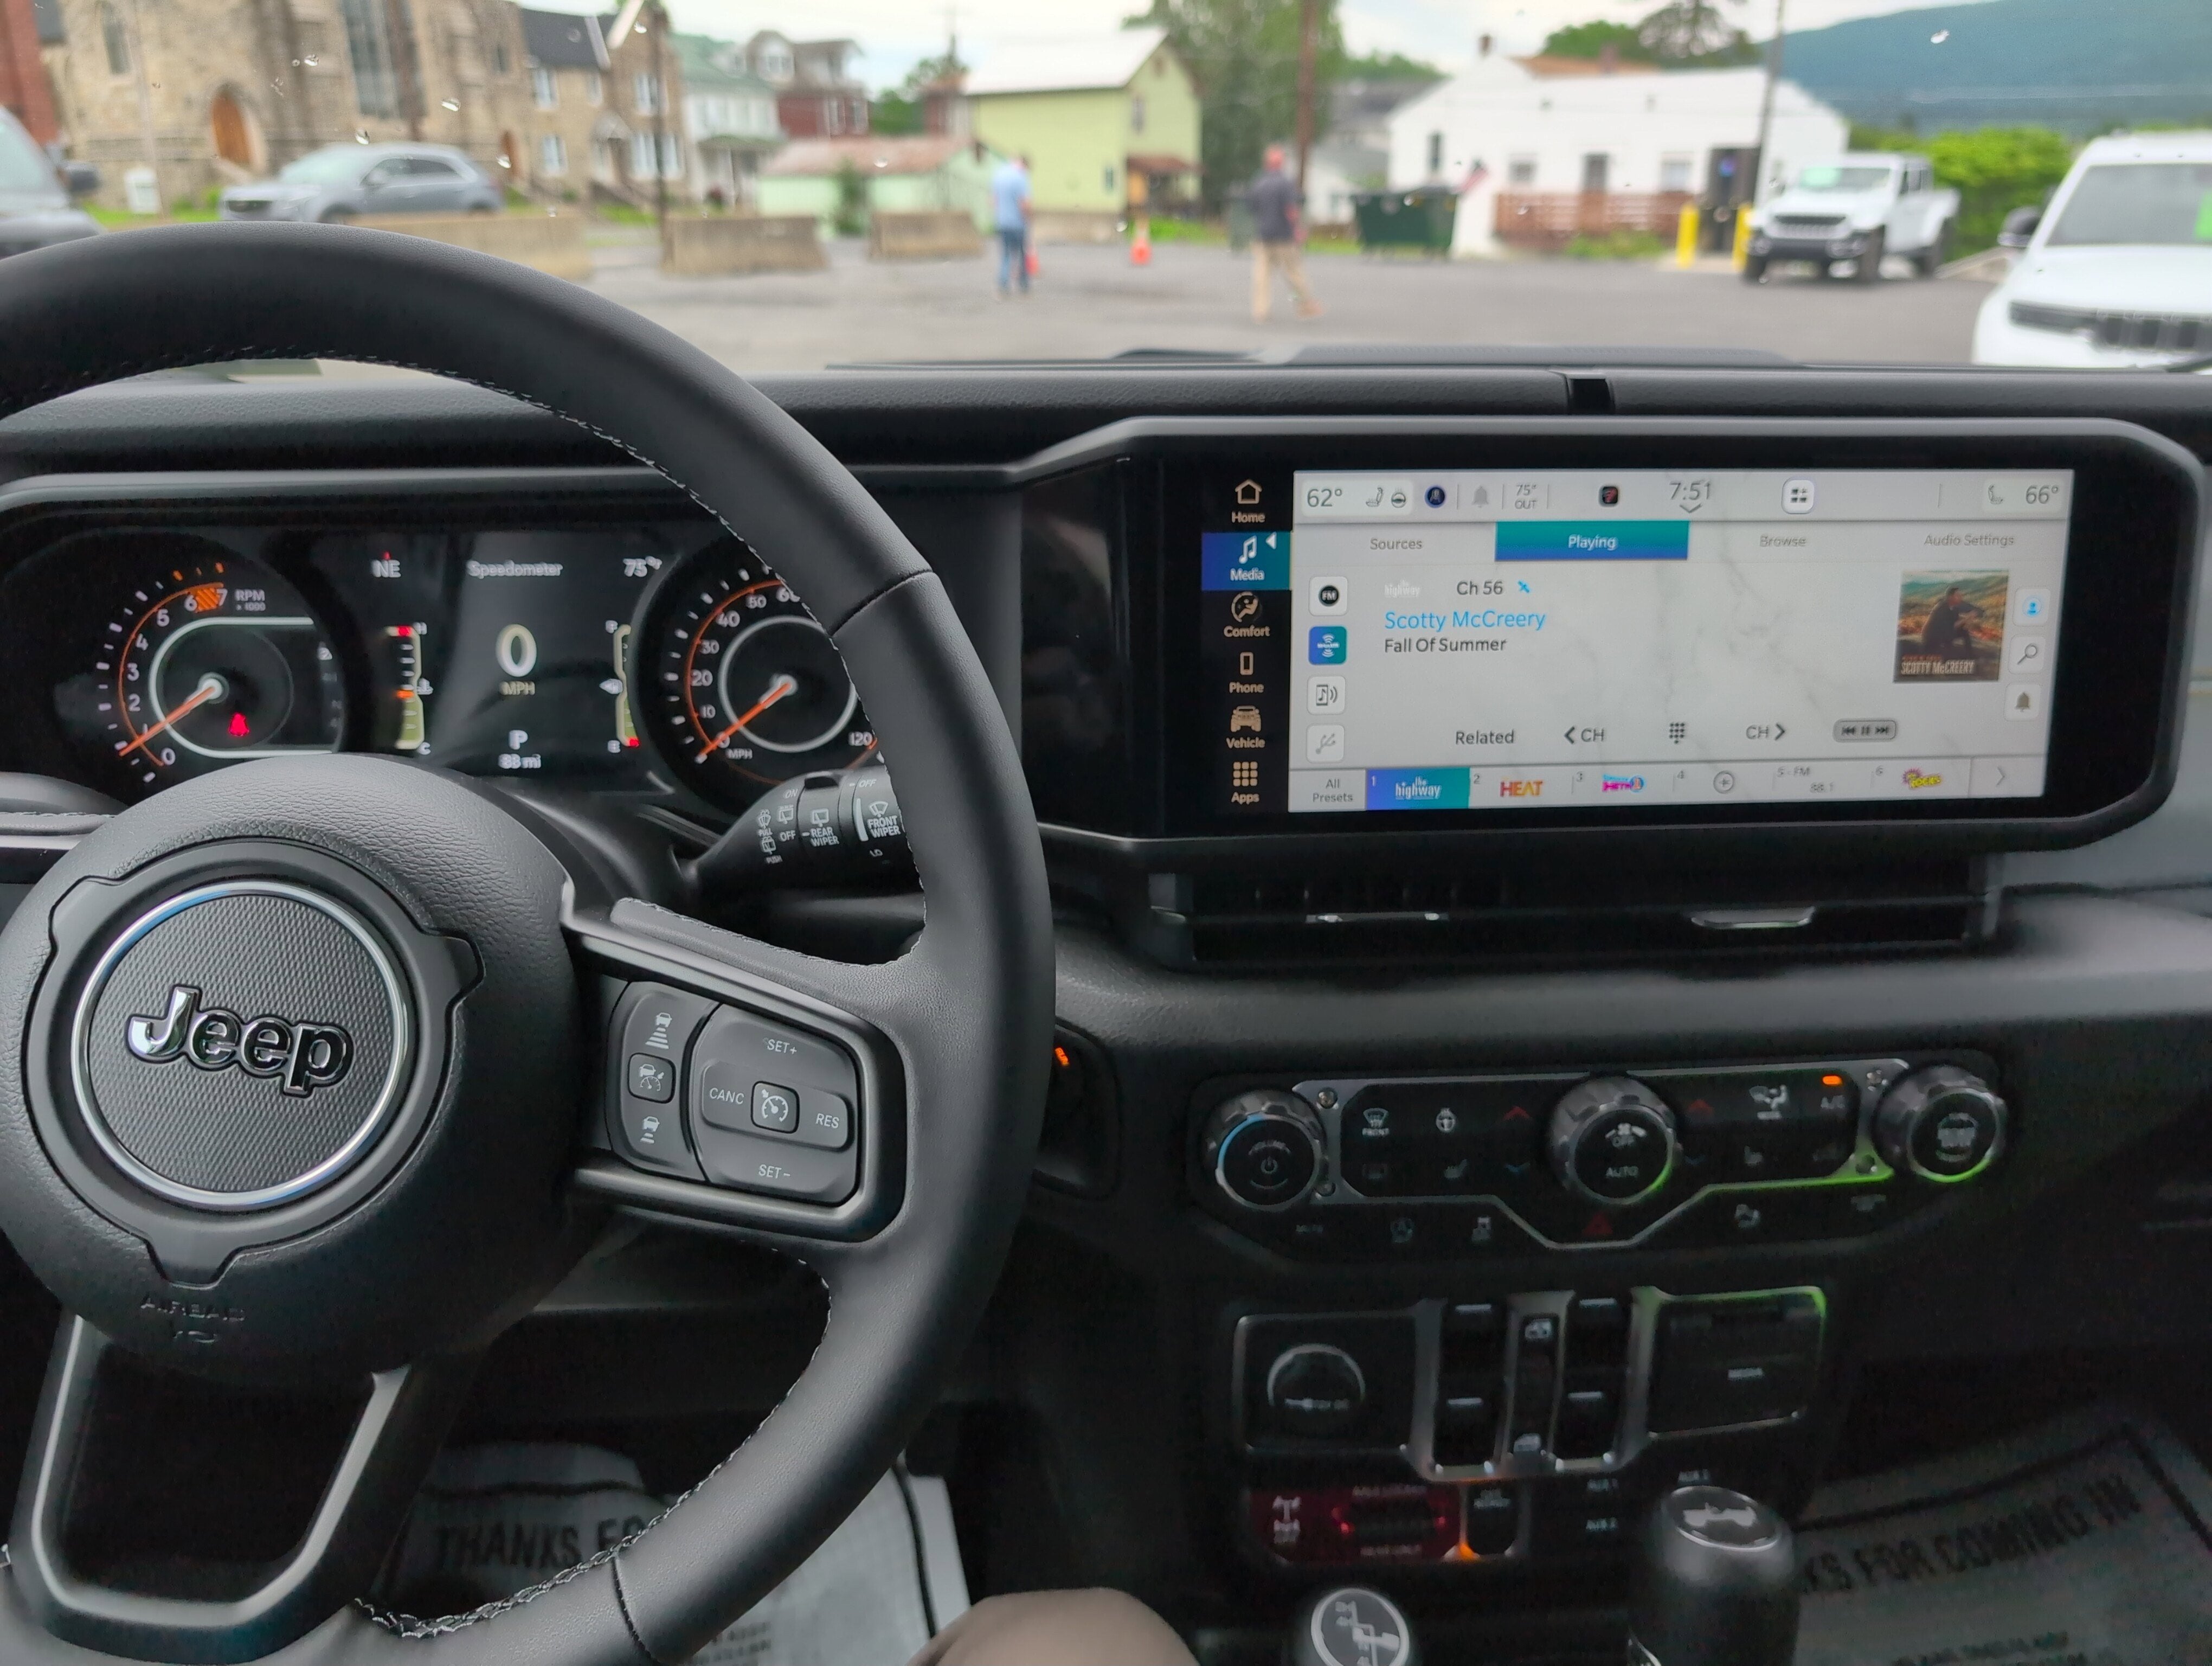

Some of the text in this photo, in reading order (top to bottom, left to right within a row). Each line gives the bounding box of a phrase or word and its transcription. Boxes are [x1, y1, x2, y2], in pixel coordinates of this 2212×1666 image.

[1307, 488, 1342, 508] 62°
[1669, 480, 1711, 501] 7:51
[2025, 485, 2059, 504] 66°
[1514, 499, 1537, 510] OUT
[1231, 510, 1266, 523] Home
[1369, 538, 1423, 550] Sources
[1568, 534, 1617, 551] Playing
[1759, 535, 1806, 547] Browse
[1925, 533, 2015, 548] Audio Settings
[371, 559, 401, 578] NE
[466, 559, 563, 579] Speedometer
[1230, 567, 1265, 581] Media
[234, 588, 266, 601] RPM
[1456, 580, 1503, 596] Ch 56
[184, 595, 197, 612] 6
[745, 594, 767, 609] 50
[1321, 591, 1336, 601] FM
[157, 609, 170, 627] 5
[716, 610, 741, 627] 40
[1384, 611, 1547, 632] Scotty McCreery
[1223, 624, 1271, 638] Comfort
[136, 633, 149, 651] 4
[700, 639, 720, 655] 30
[1385, 637, 1508, 653] Fall Of Summer
[496, 624, 537, 677] 0
[127, 662, 140, 682] 3
[1901, 661, 1932, 675] SCOTTY
[691, 669, 713, 687] 20
[499, 681, 536, 696] MPH
[1229, 681, 1265, 694] Phone
[128, 693, 142, 712] 2
[699, 704, 716, 719] 10
[509, 729, 529, 751] P
[848, 732, 873, 747] 120
[1455, 728, 1605, 745] Related CH
[1746, 725, 1770, 740] CH
[1226, 735, 1266, 749] Vehicle
[160, 747, 176, 766] 0
[725, 748, 753, 760] MPH
[859, 779, 877, 787] OFF
[1325, 778, 1340, 789] All
[1371, 775, 1377, 787] 1
[1473, 773, 1481, 785] 2
[1576, 771, 1584, 783] 3
[785, 788, 798, 799] ON
[1394, 782, 1442, 800] highway
[1500, 780, 1544, 797] HEAT
[1231, 791, 1260, 805] Apps
[1312, 792, 1354, 803] Presets
[867, 815, 898, 829] FRONT
[757, 827, 773, 837] PULL
[779, 829, 796, 842] OFF
[809, 826, 834, 838] REAR
[870, 825, 901, 838] WIPER
[811, 835, 840, 847] WIPER
[765, 854, 783, 865] PUSH
[127, 985, 351, 1096] Jeep
[709, 1087, 745, 1105] CANC
[815, 1112, 840, 1129] RES
[435, 1520, 582, 1569] THANKS
